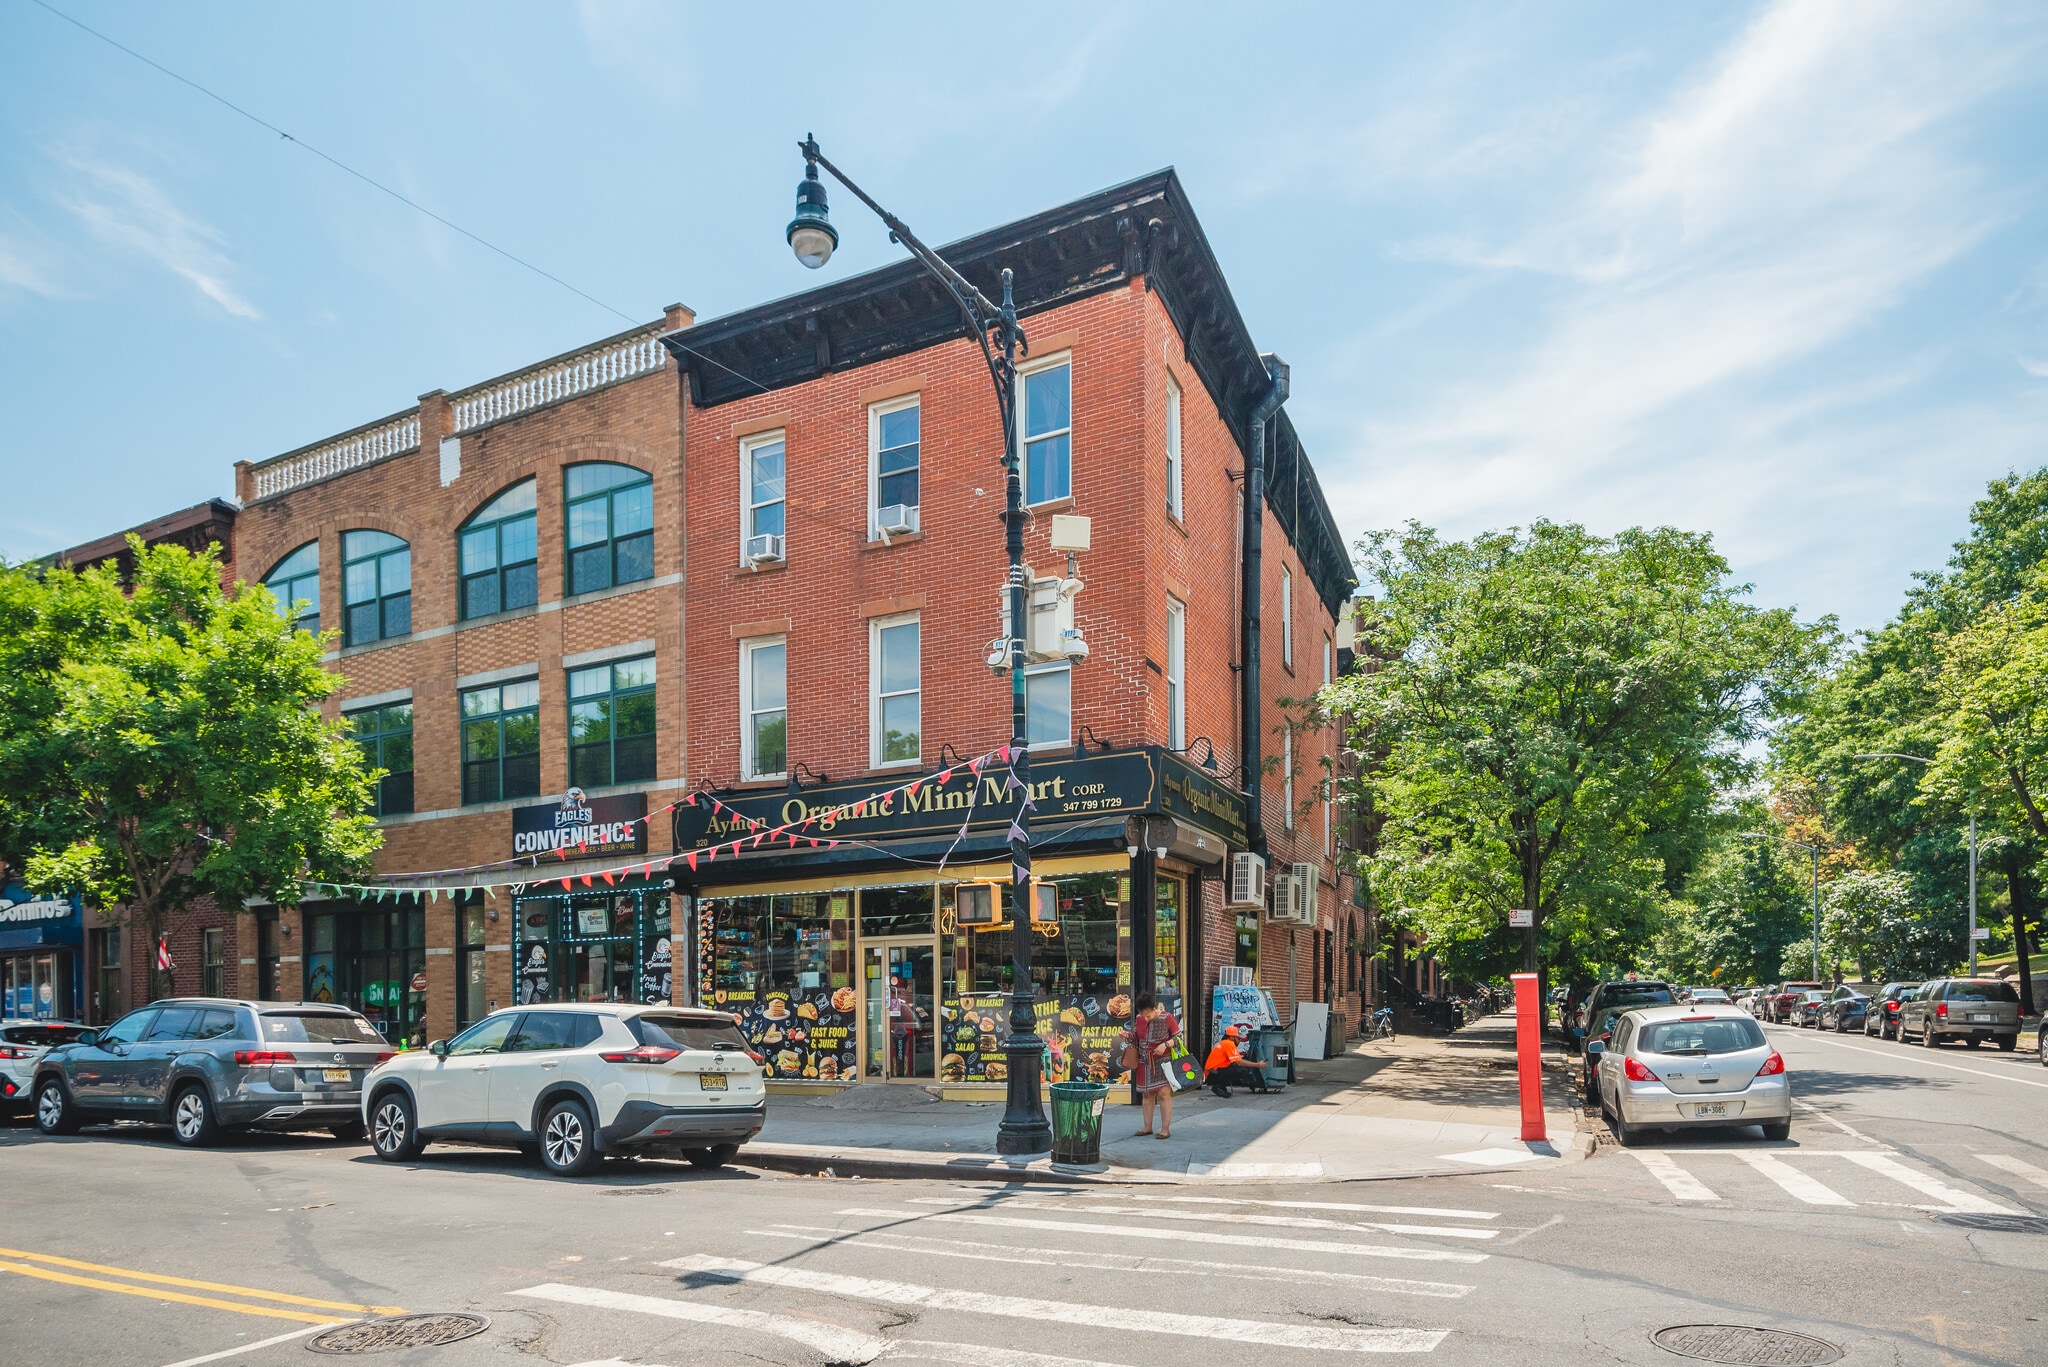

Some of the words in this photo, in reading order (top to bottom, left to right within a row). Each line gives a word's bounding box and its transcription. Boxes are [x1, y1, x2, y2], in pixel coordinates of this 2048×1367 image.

[1184, 775, 1211, 813] Organic
[781, 792, 894, 832] Organic
[900, 781, 976, 815] Mini
[983, 775, 1066, 807] Mart
[1072, 783, 1106, 797] CORP.
[1063, 802, 1080, 812] 347
[1082, 800, 1098, 810] 799
[1100, 797, 1122, 808] 1729
[556, 808, 592, 826] EAGLES
[515, 821, 635, 853] CONVENIENCE
[620, 842, 636, 850] WINE
[696, 838, 709, 848] 320
[651, 951, 672, 962] Eagles
[643, 974, 657, 982] Fresh
[644, 982, 661, 991] Coffee
[728, 991, 756, 1001] BREAKFAST
[766, 991, 789, 1001] PANCAKES
[976, 998, 1004, 1007] BREAKFAST
[811, 1027, 828, 1037] FAST
[828, 1026, 848, 1037] FOOD
[1081, 1026, 1101, 1037] FAST
[1101, 1026, 1124, 1037] FOOD
[811, 1039, 818, 1049] &
[818, 1038, 838, 1049] JUICE
[955, 1043, 976, 1052] SALAD
[1081, 1038, 1088, 1049] &
[1089, 1038, 1113, 1049] JUICE
